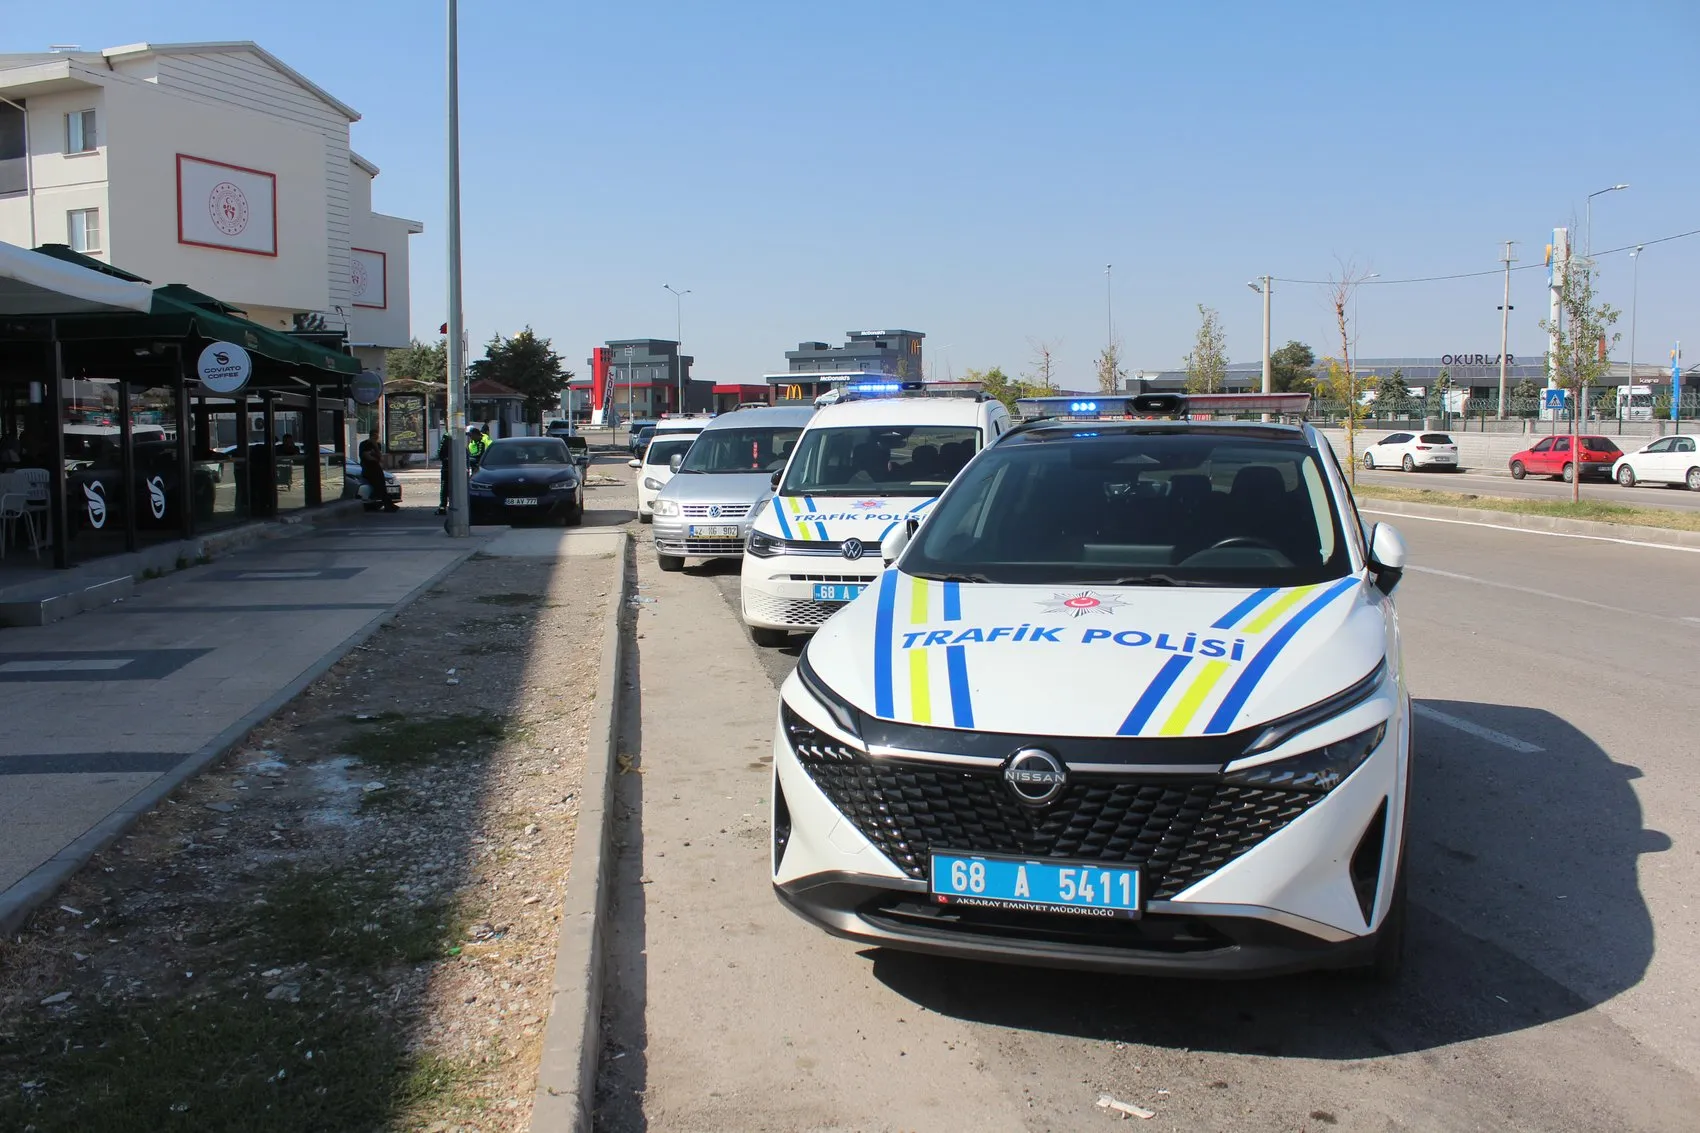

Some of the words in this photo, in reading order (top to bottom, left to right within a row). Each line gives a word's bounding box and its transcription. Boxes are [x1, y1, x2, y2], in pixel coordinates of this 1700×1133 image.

[207, 372, 239, 380] COFFEE
[794, 512, 859, 522] TRAFİK
[820, 586, 834, 599] 68
[843, 586, 849, 600] A
[901, 623, 1068, 649] TRAFİK
[1081, 628, 1246, 662] POLİSİ
[1005, 771, 1065, 782] NISSAN
[951, 860, 986, 893] 68
[1014, 866, 1030, 898] A
[1059, 868, 1130, 905] 5411
[956, 897, 1001, 907] AKSARAY
[1002, 900, 1048, 912] EMNİYET
